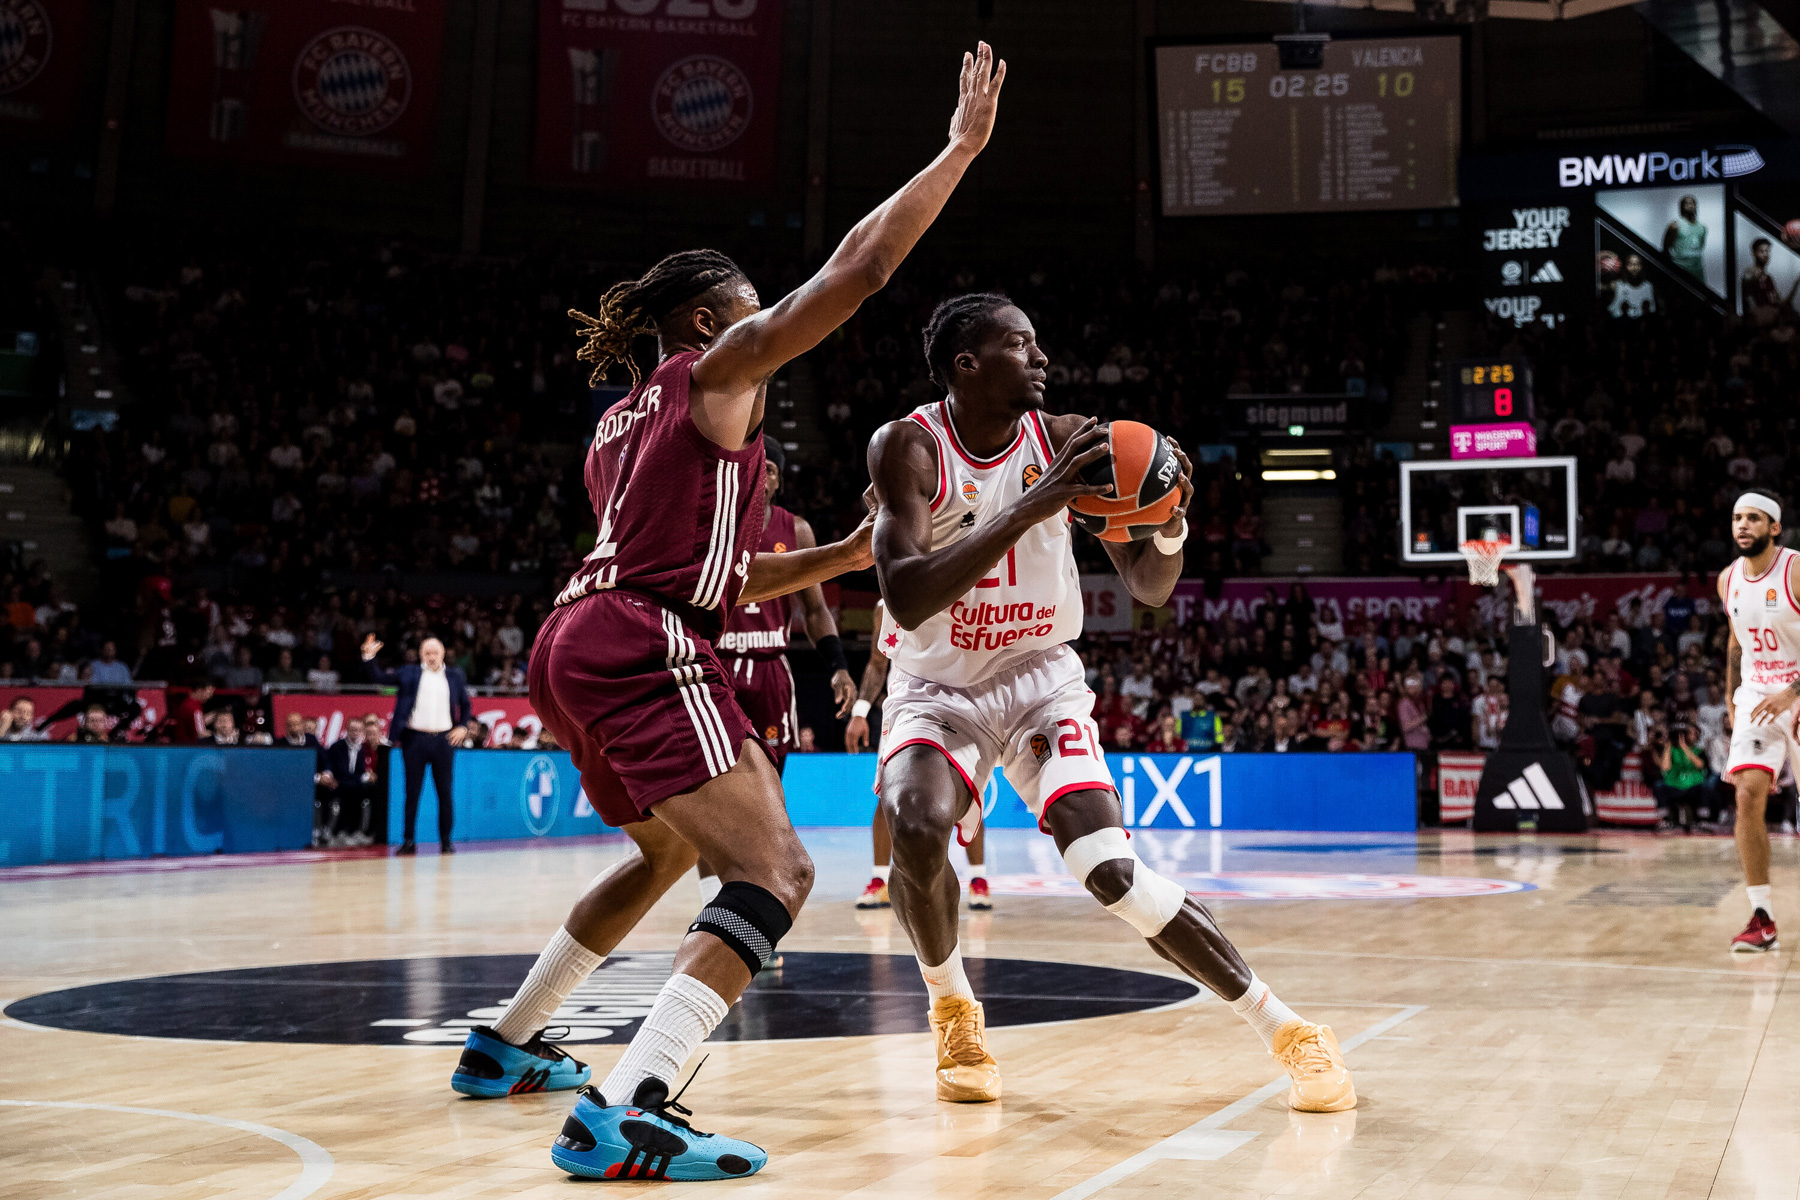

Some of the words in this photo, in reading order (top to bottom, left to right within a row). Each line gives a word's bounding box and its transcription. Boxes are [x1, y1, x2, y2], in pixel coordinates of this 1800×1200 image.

[1195, 53, 1258, 74] FCBB
[1352, 47, 1424, 68] VALENCIA
[1211, 78, 1246, 103] 15
[1269, 73, 1350, 98] 02:25
[1377, 72, 1415, 98] 10
[1511, 206, 1571, 229] YOUR
[1482, 228, 1563, 251] JERSEY
[1246, 400, 1347, 429] siegmund
[1494, 388, 1513, 416] 8
[975, 546, 1017, 588] 1
[950, 601, 1033, 625] Cultura
[1036, 605, 1056, 620] del
[1203, 596, 1343, 622] MAGTA
[1748, 628, 1778, 652] 30
[1056, 718, 1100, 762] 21
[1121, 755, 1223, 827] iX1
[0, 751, 227, 862] TRIC
